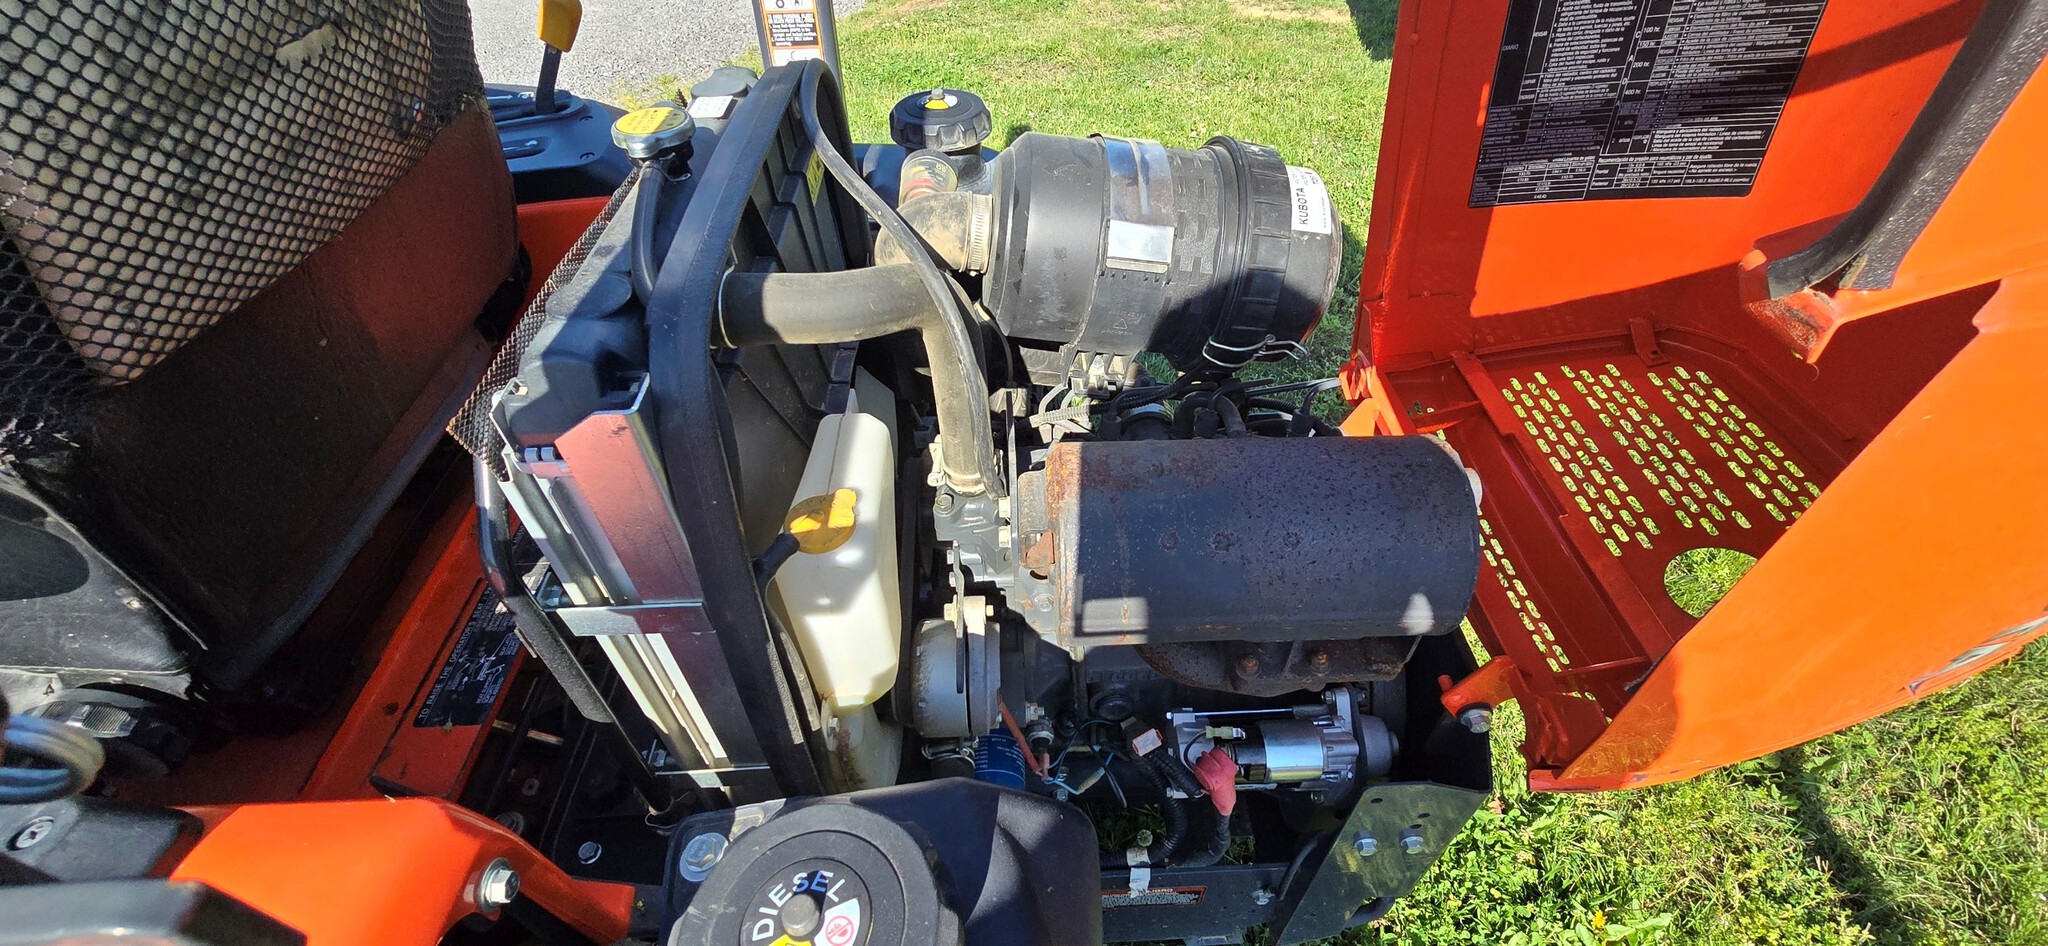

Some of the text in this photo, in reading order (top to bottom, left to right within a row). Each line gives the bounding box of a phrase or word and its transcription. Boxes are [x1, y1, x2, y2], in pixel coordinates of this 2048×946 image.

[1296, 187, 1309, 225] KUBOTA
[418, 708, 428, 719] TO
[440, 665, 451, 680] THE
[752, 870, 845, 941] DIESEL
